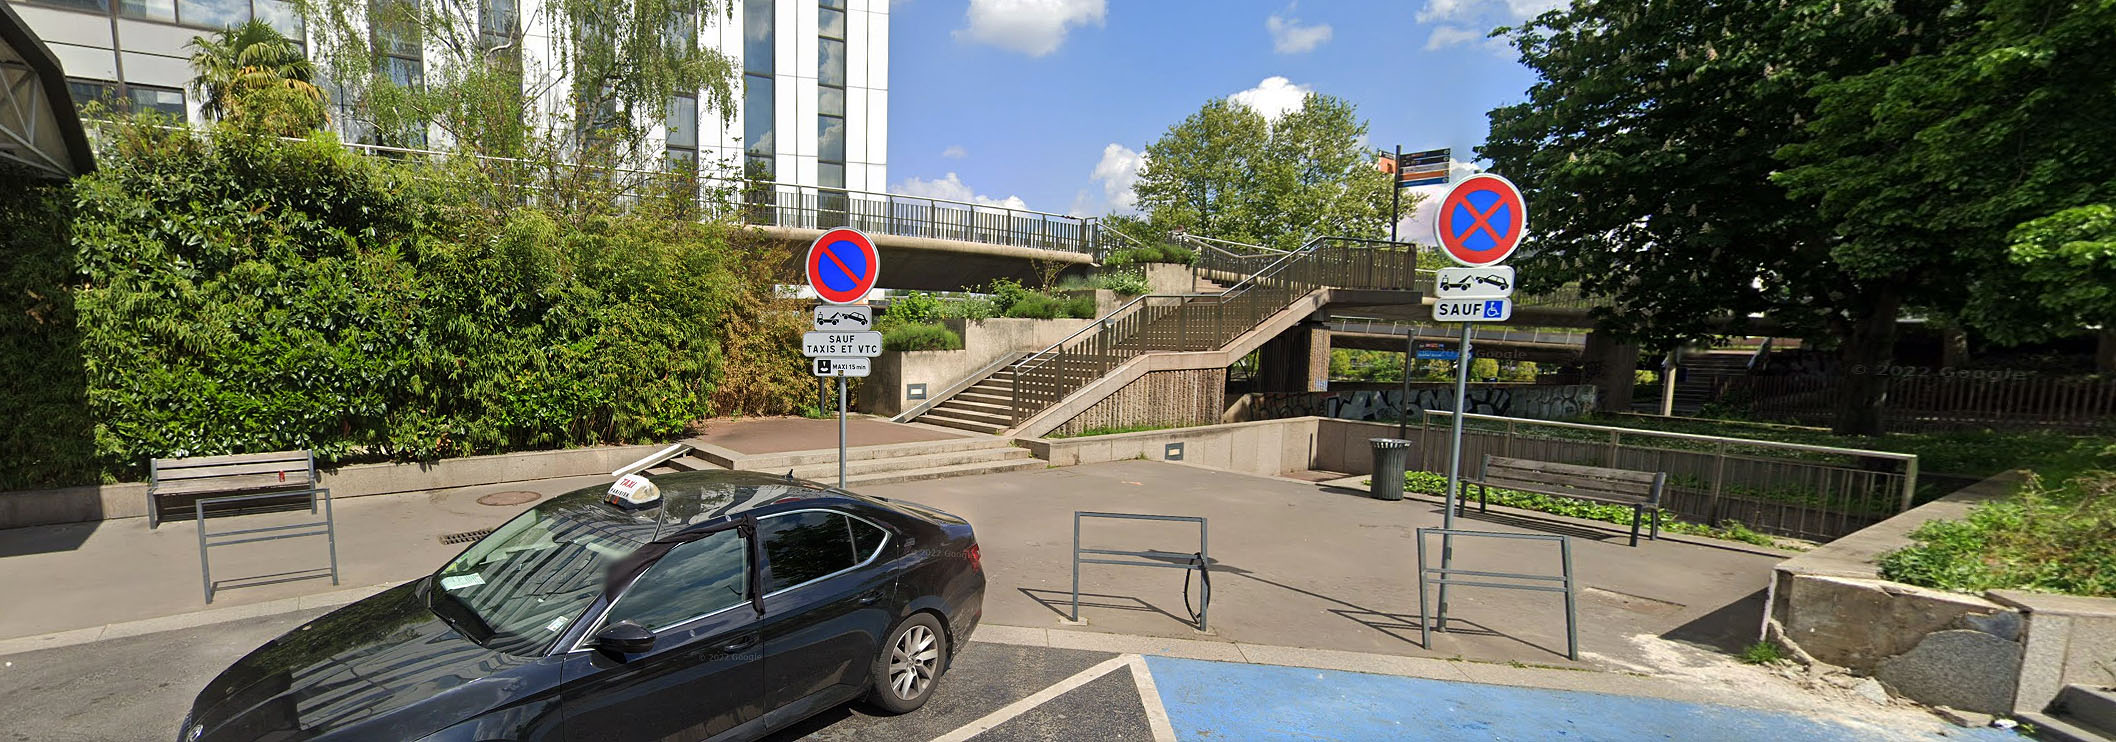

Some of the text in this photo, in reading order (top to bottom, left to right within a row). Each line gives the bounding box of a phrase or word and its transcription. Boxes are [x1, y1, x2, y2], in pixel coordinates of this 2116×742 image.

[1439, 303, 1482, 316] SAUF
[829, 335, 855, 343] SAUF
[807, 345, 877, 353] TAXIS ET VTC
